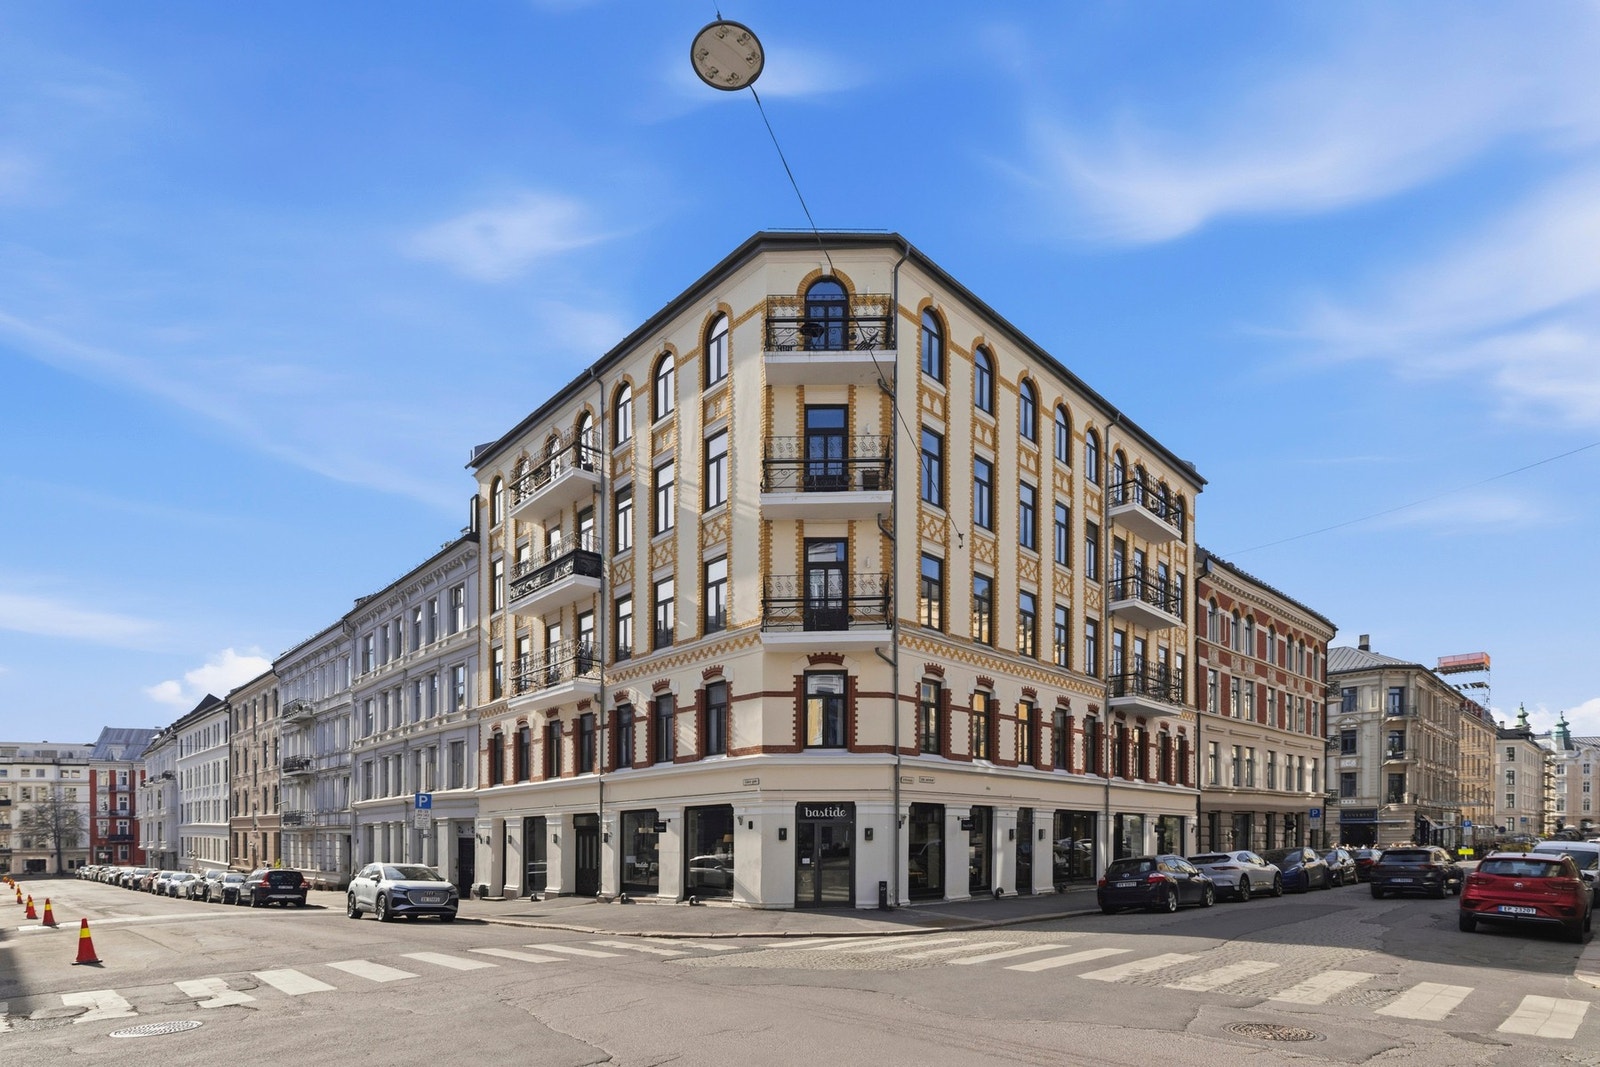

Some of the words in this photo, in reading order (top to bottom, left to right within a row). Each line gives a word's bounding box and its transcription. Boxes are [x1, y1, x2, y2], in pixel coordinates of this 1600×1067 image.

[419, 796, 428, 807] P
[804, 806, 847, 817] bastide
[1312, 809, 1318, 817] P
